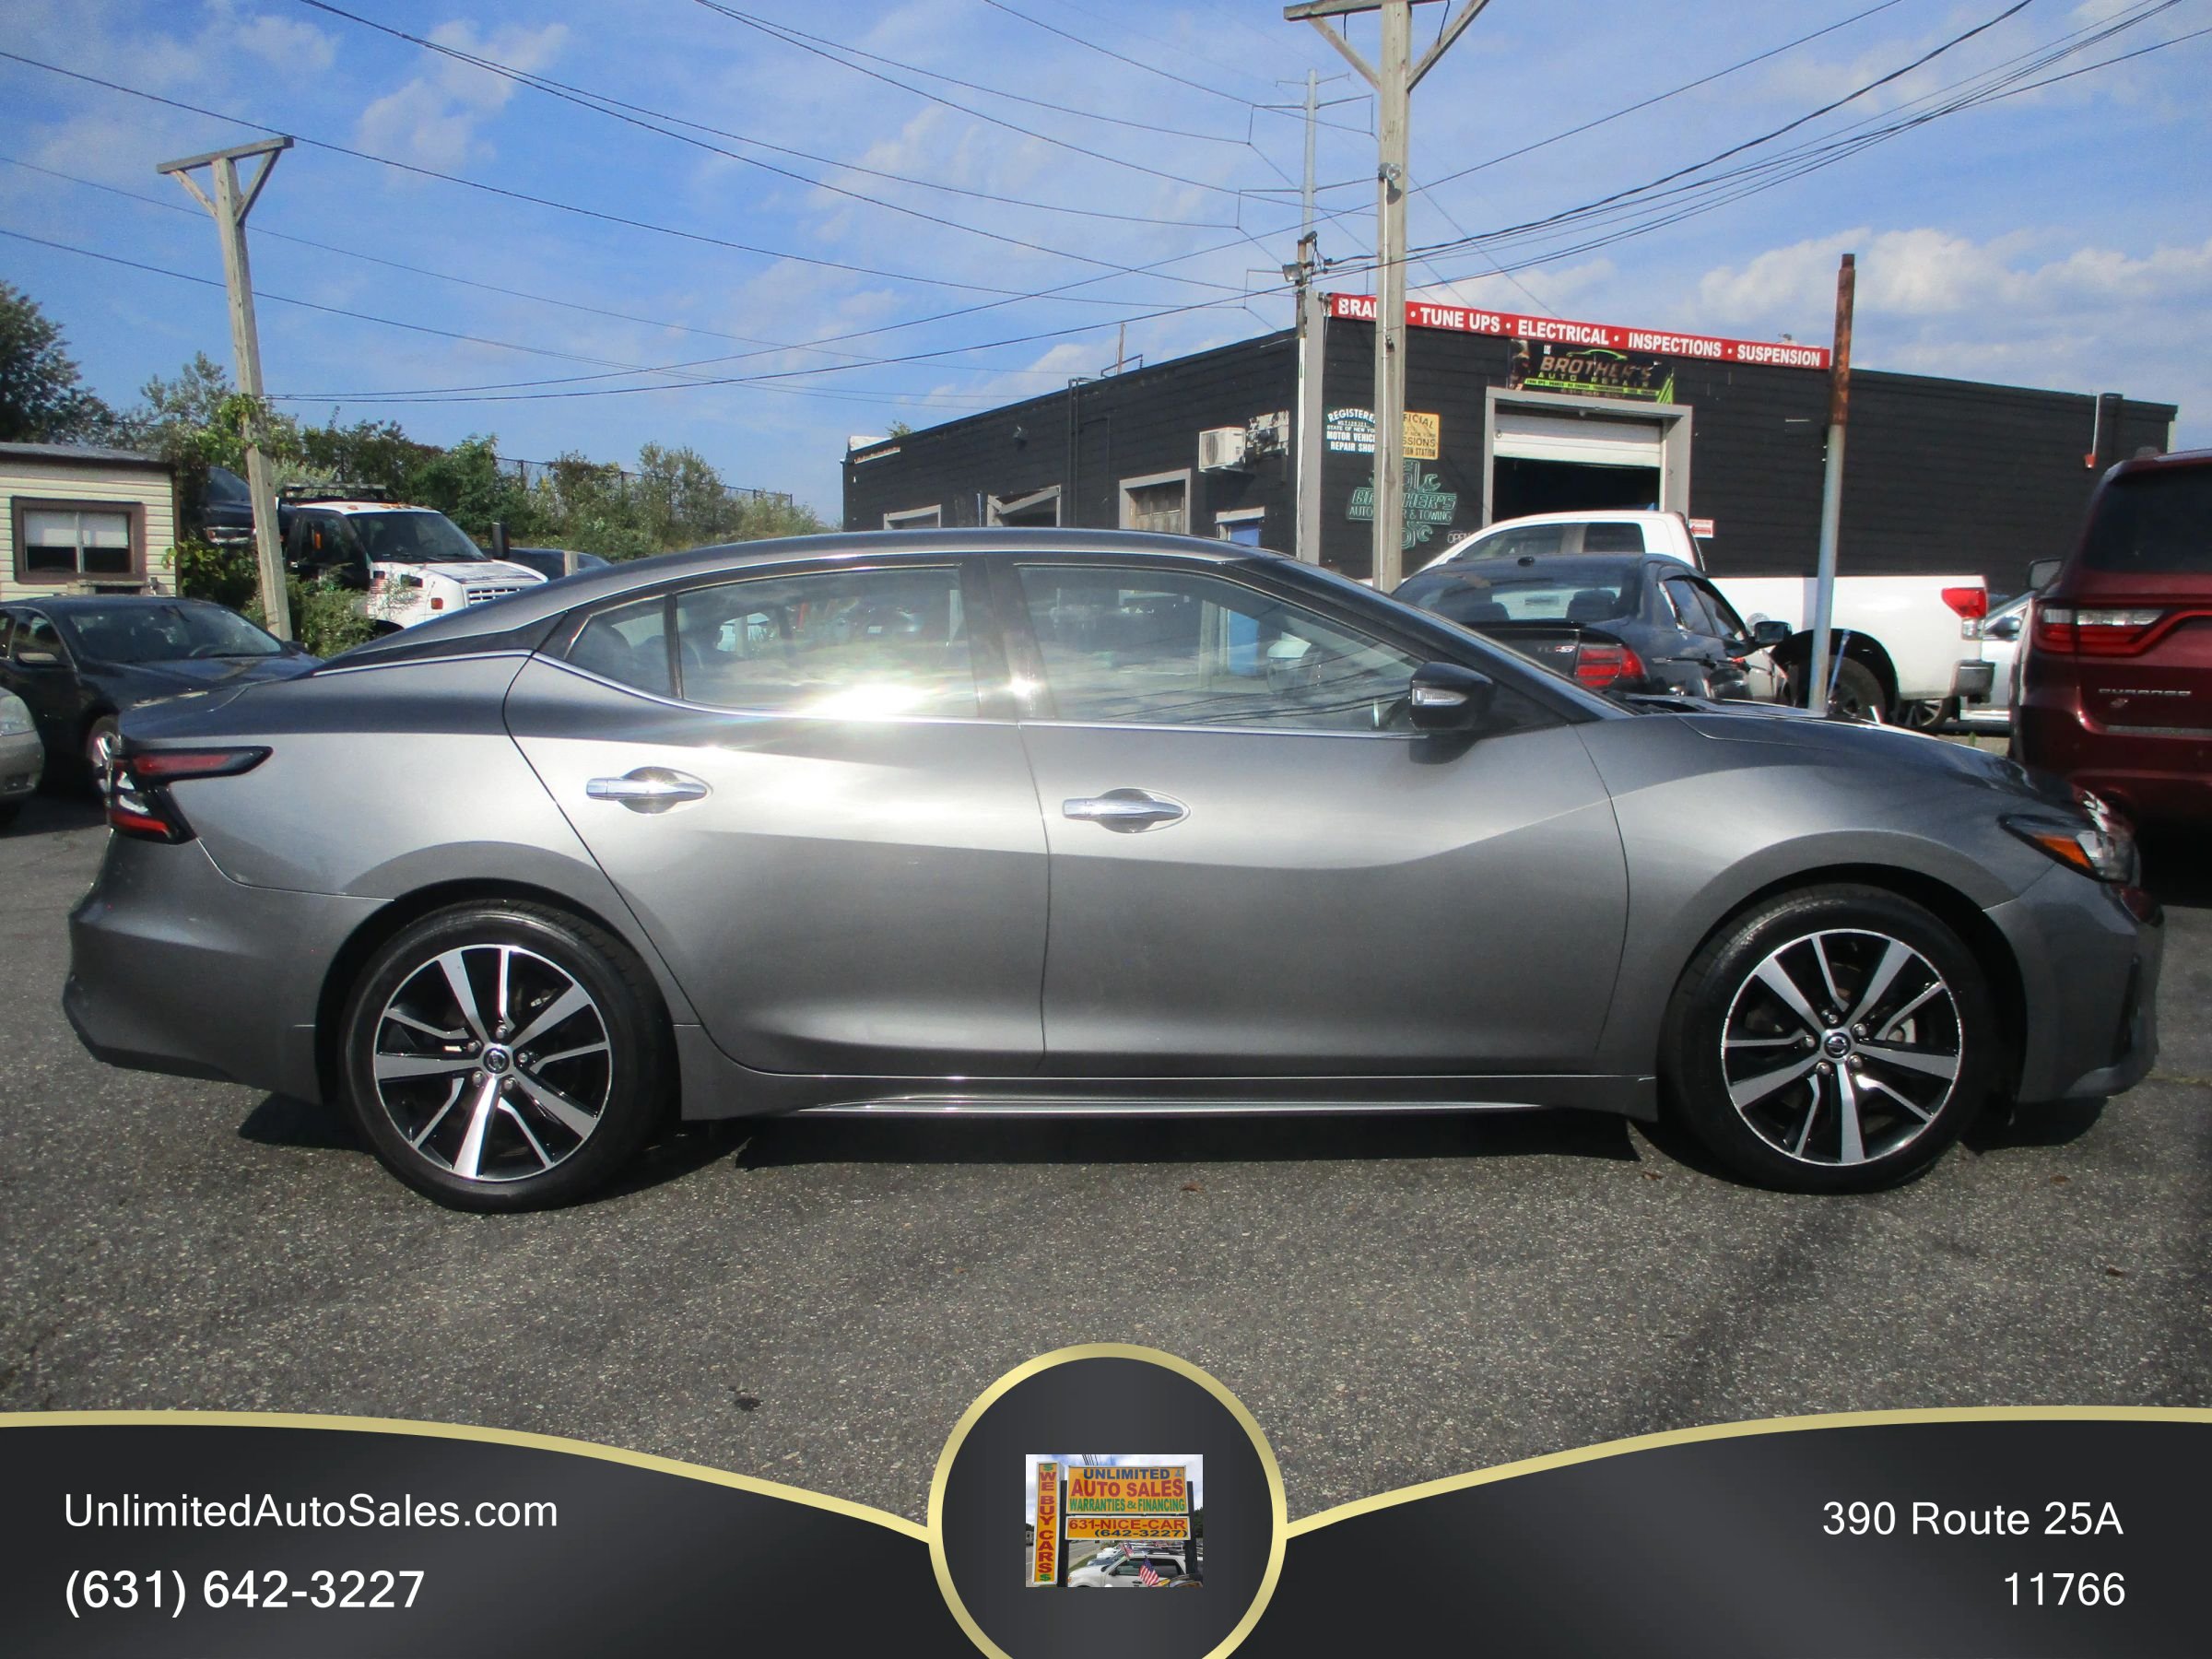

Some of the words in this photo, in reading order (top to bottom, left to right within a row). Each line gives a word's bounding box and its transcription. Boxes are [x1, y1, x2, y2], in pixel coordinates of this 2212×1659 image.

[1338, 298, 1376, 318] BRA
[1420, 307, 1465, 328] TUNE
[1469, 315, 1500, 333] UPS
[1518, 319, 1609, 346] ELECTRICAL
[1629, 332, 1722, 358] INSPECTIONS
[1737, 345, 1821, 367] SUSPENSION
[1540, 356, 1652, 380] BROTHER'S
[1537, 371, 1577, 382] AUTO
[1591, 376, 1649, 388] REPAIR
[1403, 413, 1434, 429] FICIAL
[1327, 430, 1350, 441] MOTOR
[1353, 432, 1375, 443] VEHIC
[1403, 436, 1435, 447] SSIONS
[1330, 441, 1356, 452] REPAIR
[1349, 505, 1373, 517] AUTO
[1419, 509, 1453, 522] TOWING
